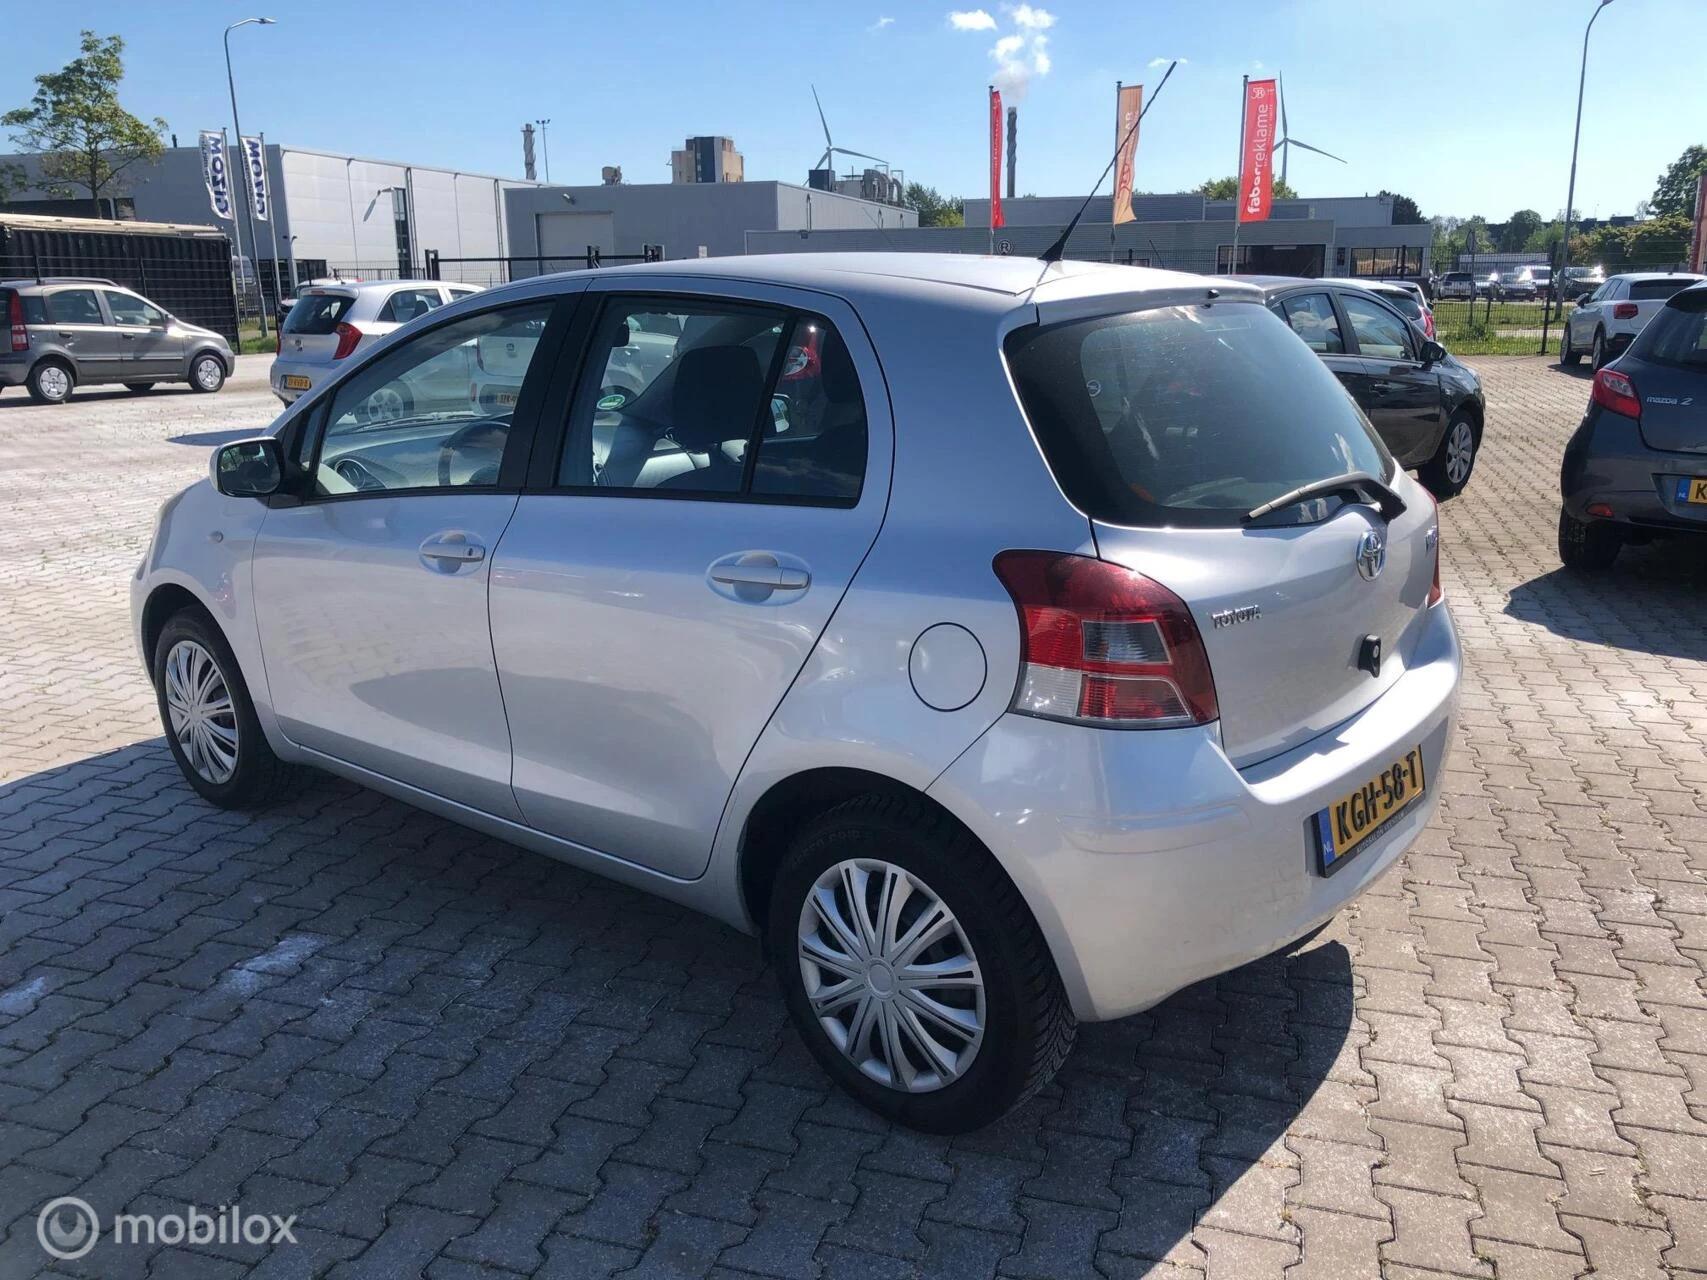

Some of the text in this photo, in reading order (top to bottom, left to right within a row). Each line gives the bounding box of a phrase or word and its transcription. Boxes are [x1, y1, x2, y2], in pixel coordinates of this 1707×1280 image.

[1247, 103, 1269, 214] faberreklame
[1647, 396, 1693, 406] mazda 2
[1211, 604, 1262, 629] TOYOTA
[1336, 750, 1417, 845] KGH-58-T
[1323, 841, 1333, 856] NL
